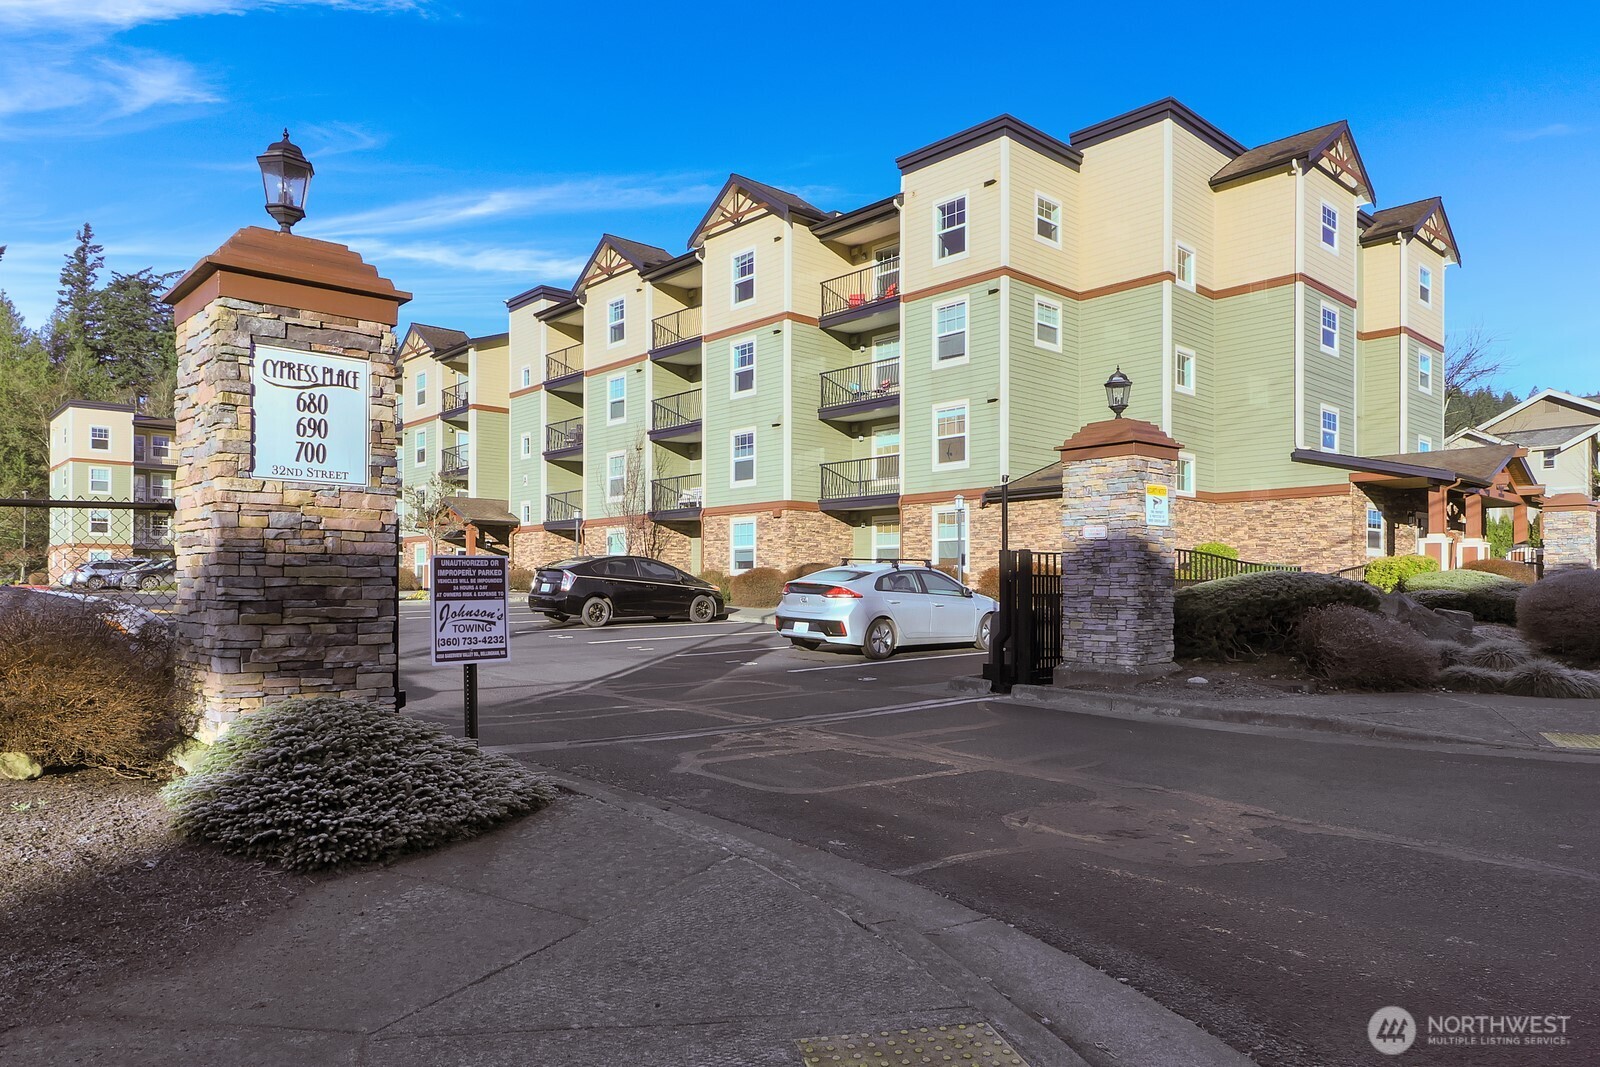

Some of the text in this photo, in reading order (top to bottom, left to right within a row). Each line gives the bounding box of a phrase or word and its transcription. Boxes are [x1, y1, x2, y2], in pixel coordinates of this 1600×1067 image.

[262, 358, 360, 389] CYPRESS PLACE
[296, 391, 329, 415] 680
[296, 416, 329, 439] 690
[295, 441, 327, 464] 700
[272, 465, 349, 480] 32ND STREET
[490, 559, 499, 567] OR
[437, 569, 477, 577] IMPROPERLY
[439, 603, 504, 633] Johnson's
[452, 624, 493, 633] TOWING
[437, 635, 505, 648] (360) 733-4232
